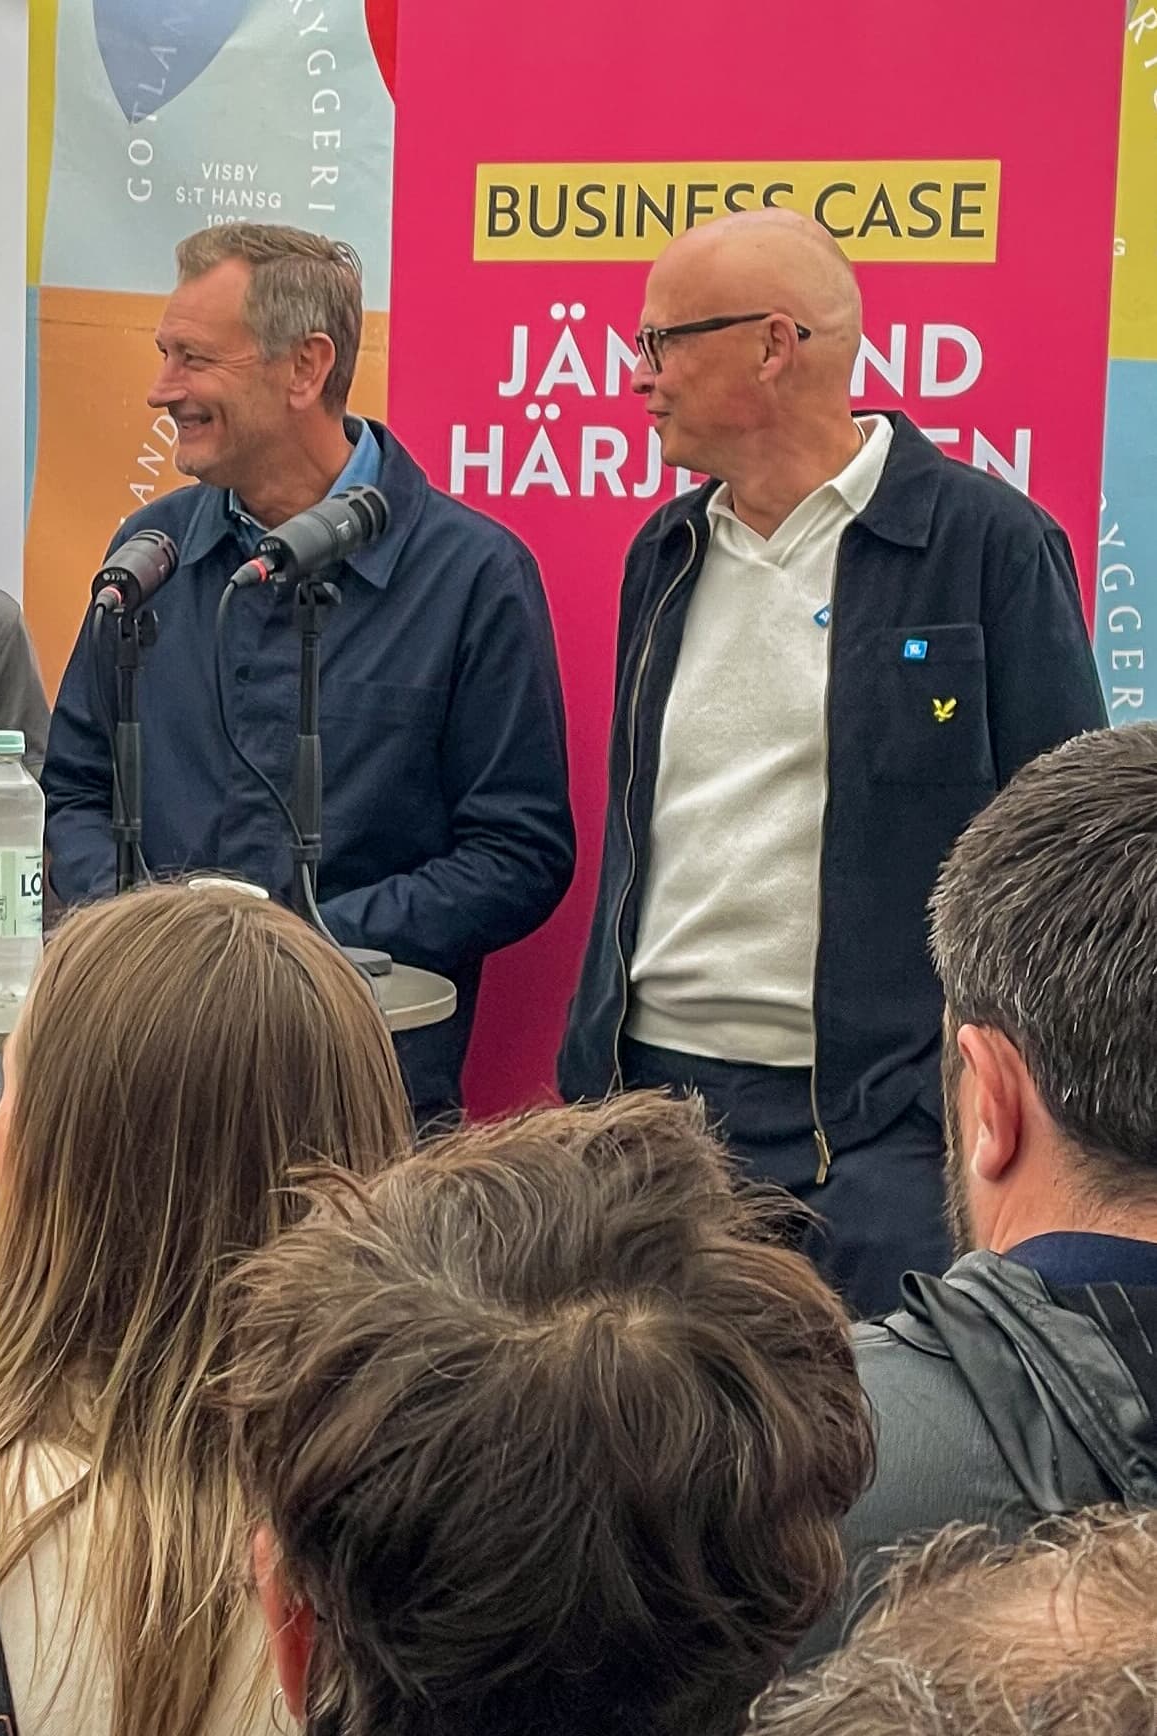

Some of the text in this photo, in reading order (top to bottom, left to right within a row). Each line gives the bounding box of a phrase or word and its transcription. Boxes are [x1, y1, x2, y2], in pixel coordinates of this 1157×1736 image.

[298, 11, 342, 212] YGGERI
[201, 161, 259, 182] VISBY
[175, 187, 282, 208] S:T HANSG
[814, 181, 987, 239] CASE
[498, 303, 984, 398] JÄND
[21, 872, 43, 897] LO
